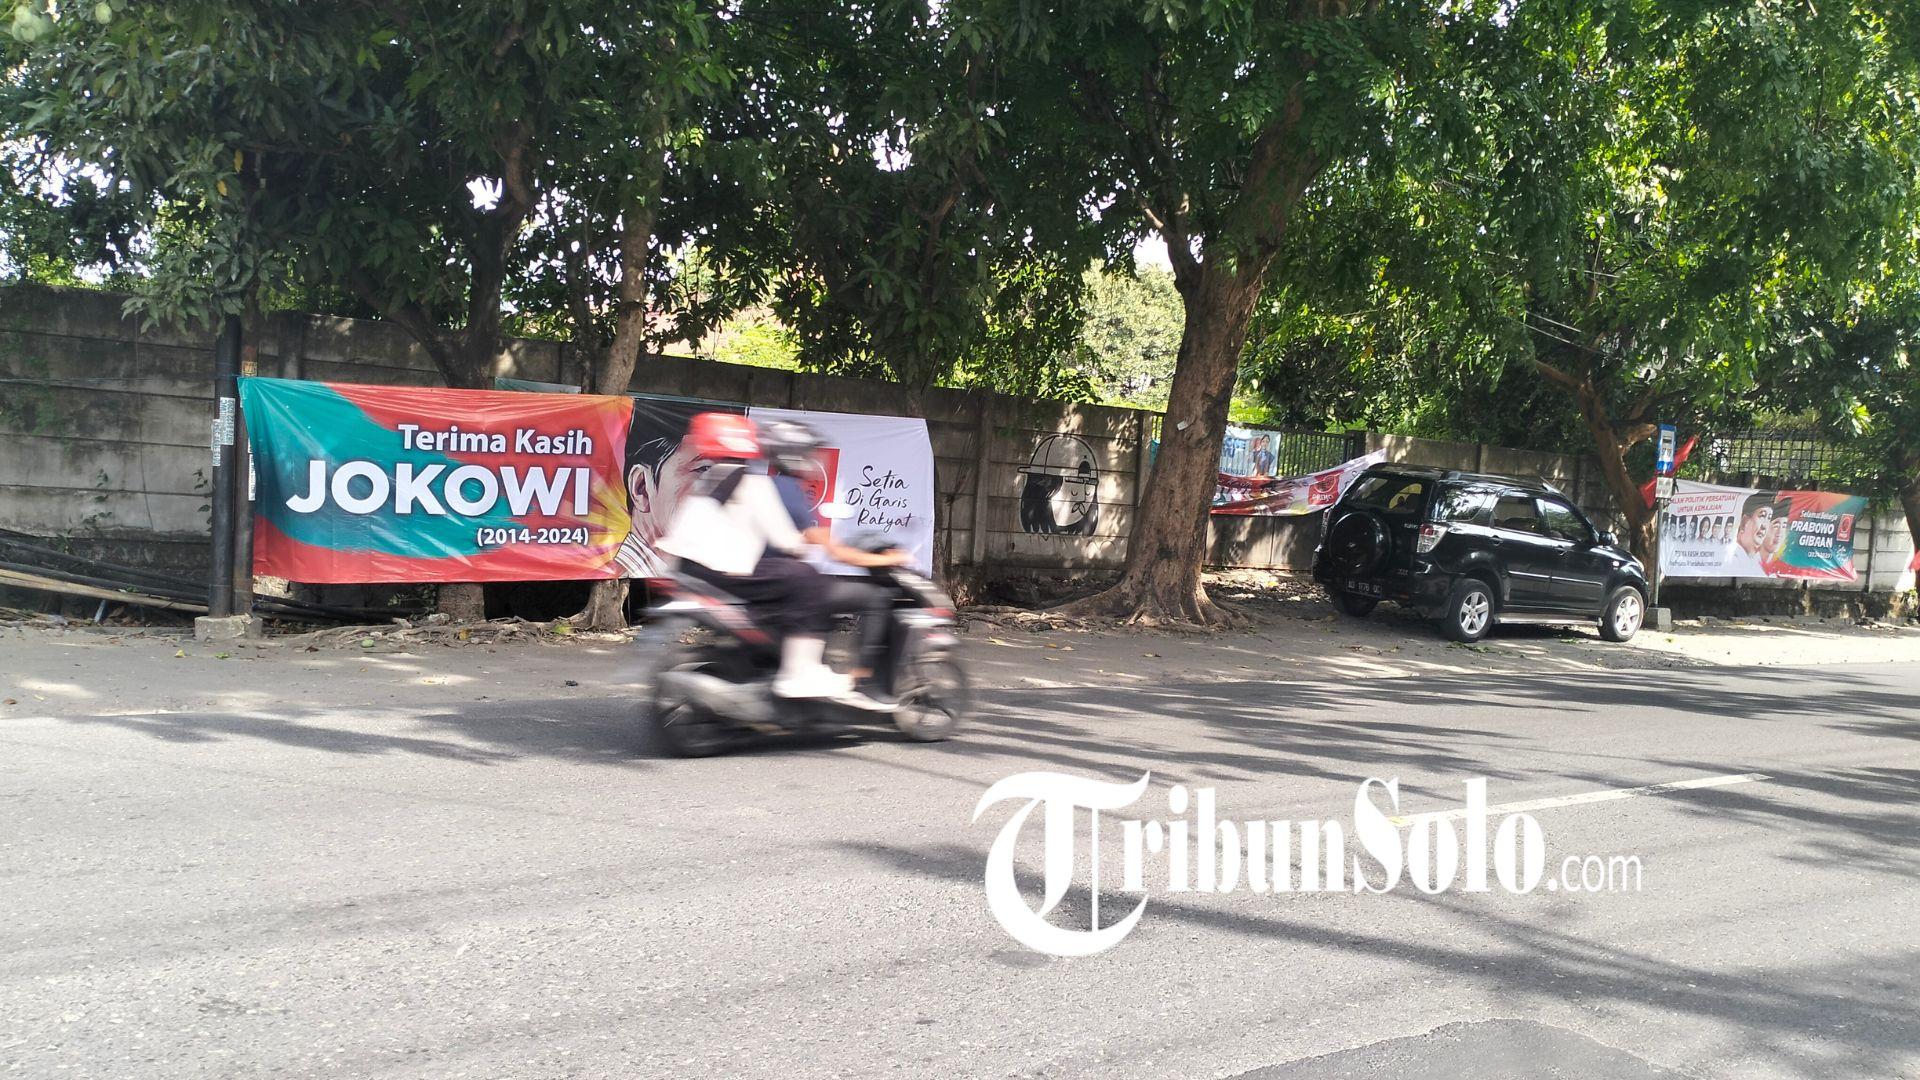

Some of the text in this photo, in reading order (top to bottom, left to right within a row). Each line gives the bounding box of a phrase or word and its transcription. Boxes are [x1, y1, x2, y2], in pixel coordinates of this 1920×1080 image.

[398, 424, 592, 455] Terima Kasih
[286, 460, 590, 516] JOKOWI
[860, 465, 909, 489] Setia
[845, 488, 907, 509] Di Garis
[857, 507, 916, 533] Rakyat
[1791, 521, 1834, 534] PRABOWO
[476, 527, 589, 547] (2014-2024)
[1799, 535, 1833, 548] GIBRAN
